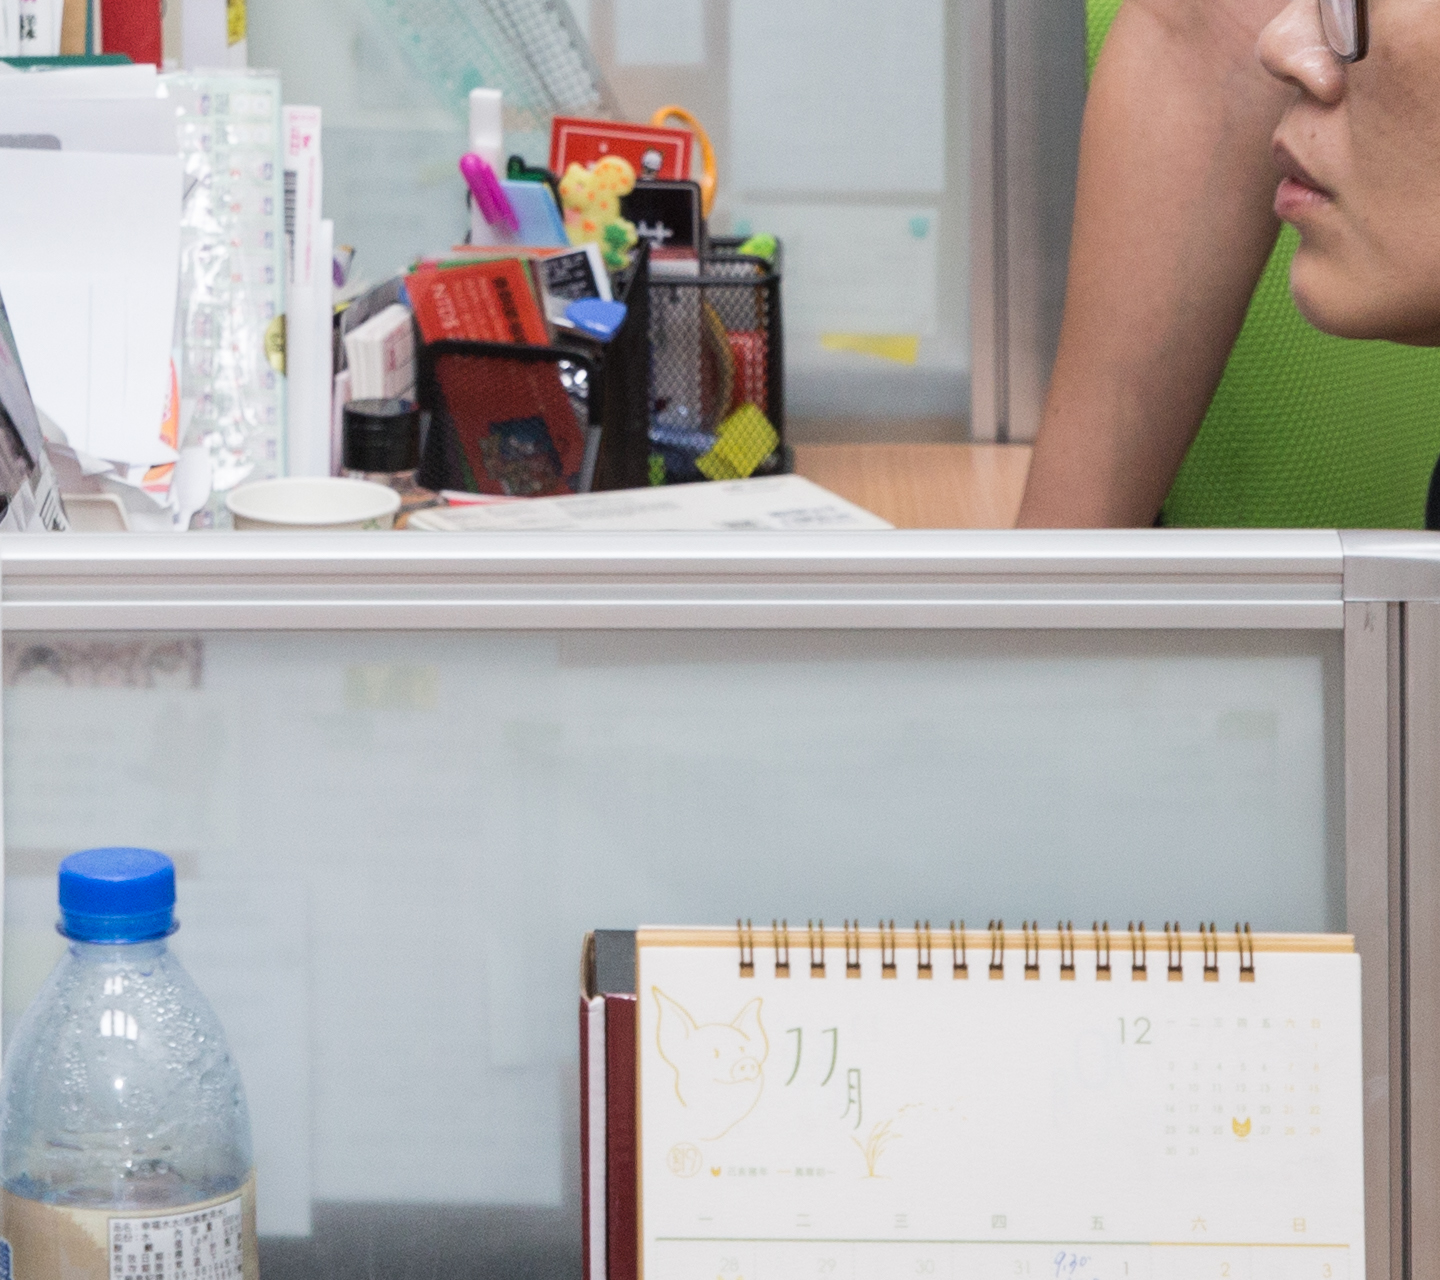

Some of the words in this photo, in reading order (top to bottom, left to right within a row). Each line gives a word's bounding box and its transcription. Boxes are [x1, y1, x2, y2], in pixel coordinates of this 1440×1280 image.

[1117, 1016, 1153, 1045] 12
[991, 1214, 1007, 1230] 四
[1090, 1215, 1105, 1231] 五
[1191, 1216, 1207, 1232] 六
[1221, 1262, 1231, 1278] 2
[1322, 1263, 1333, 1279] 3
